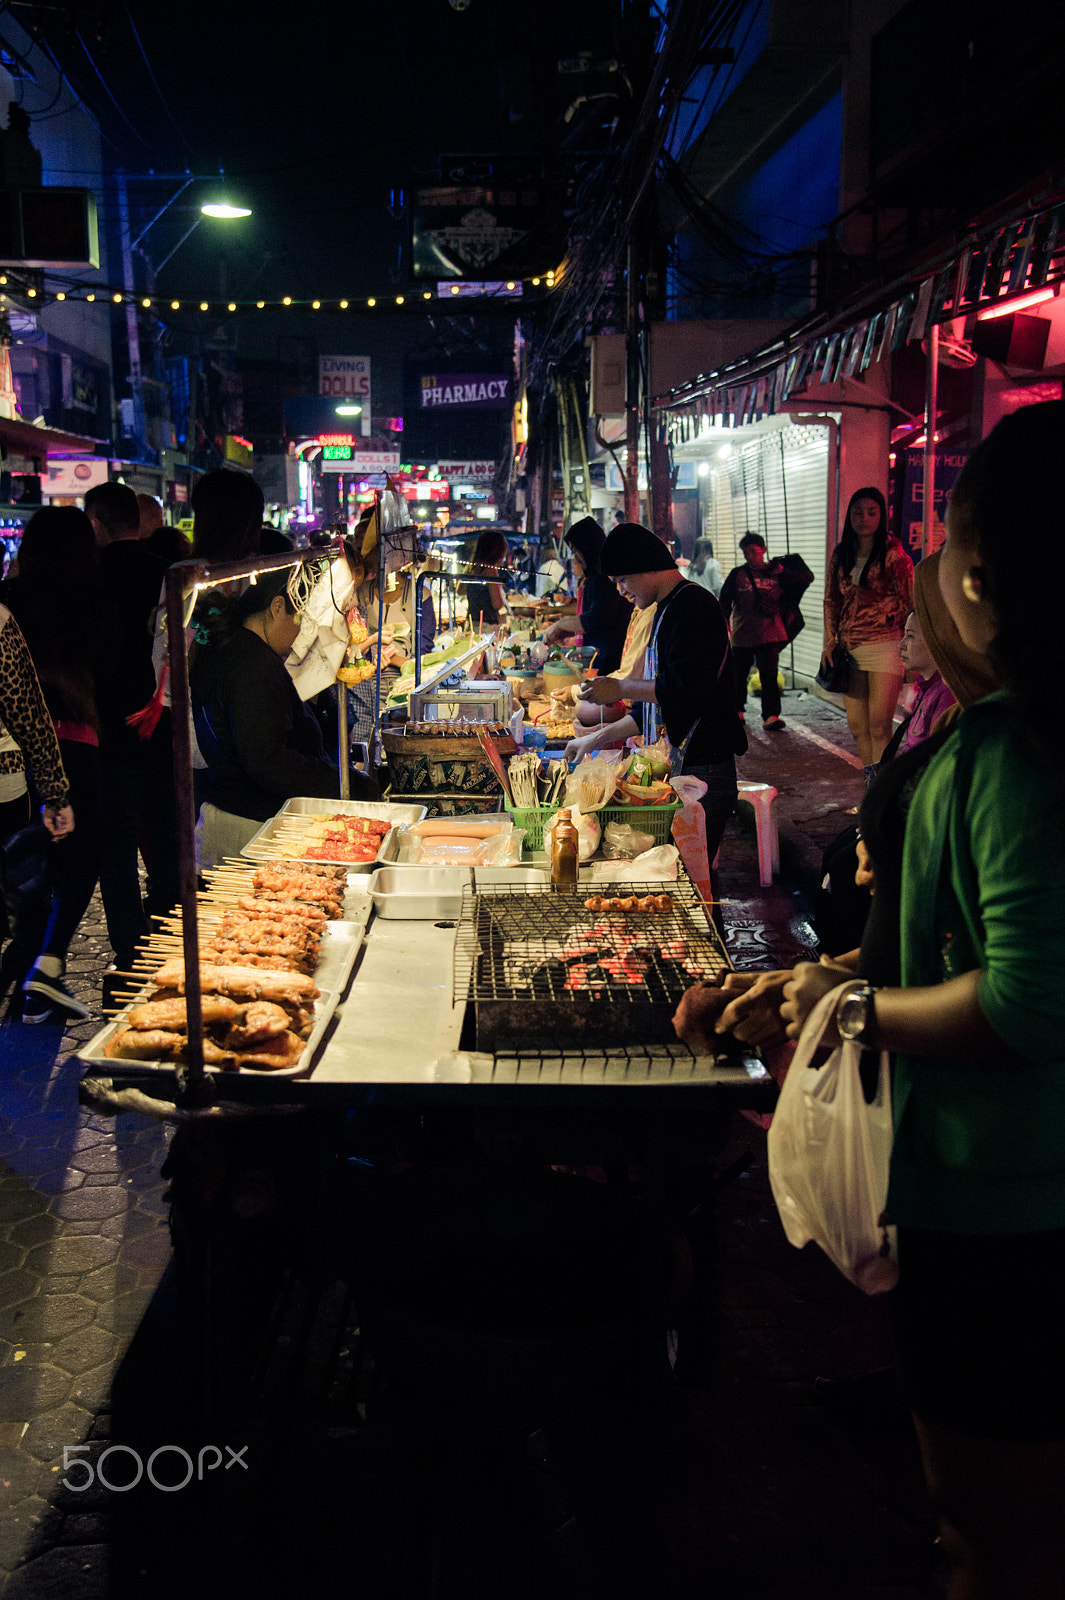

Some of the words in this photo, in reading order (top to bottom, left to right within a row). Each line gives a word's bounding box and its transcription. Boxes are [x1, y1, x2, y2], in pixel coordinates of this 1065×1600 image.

[323, 361, 365, 372] LIVING
[322, 375, 370, 396] DOLLS
[421, 379, 509, 407] PHARMACY
[357, 454, 390, 464] DOLLS
[438, 465, 465, 475] HAPPY
